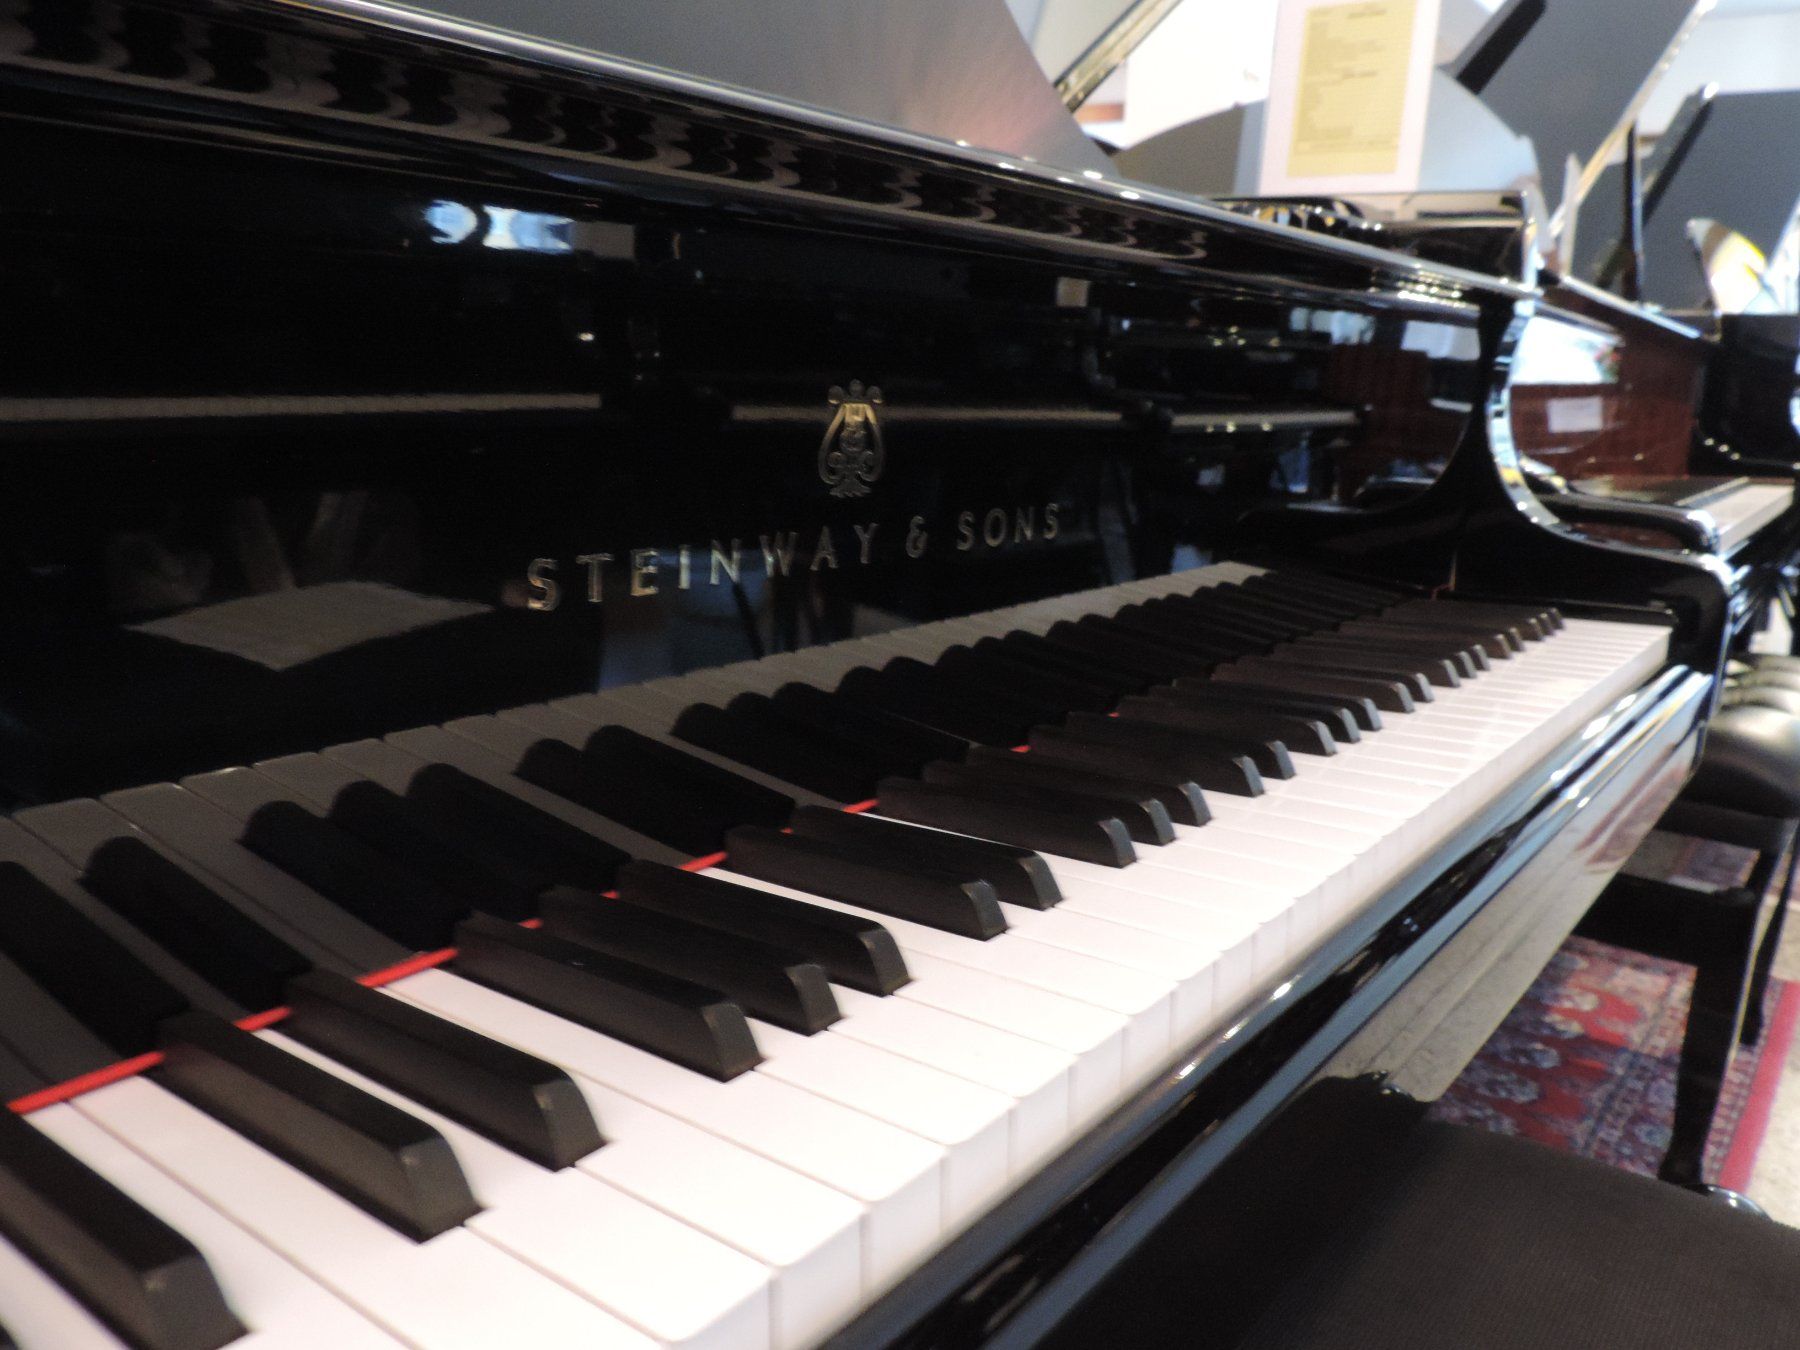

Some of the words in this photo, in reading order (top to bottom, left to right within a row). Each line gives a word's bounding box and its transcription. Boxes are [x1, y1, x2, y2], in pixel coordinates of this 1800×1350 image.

[527, 522, 879, 611] STEINWAY
[906, 515, 928, 558] &
[956, 503, 1060, 551] SONS
